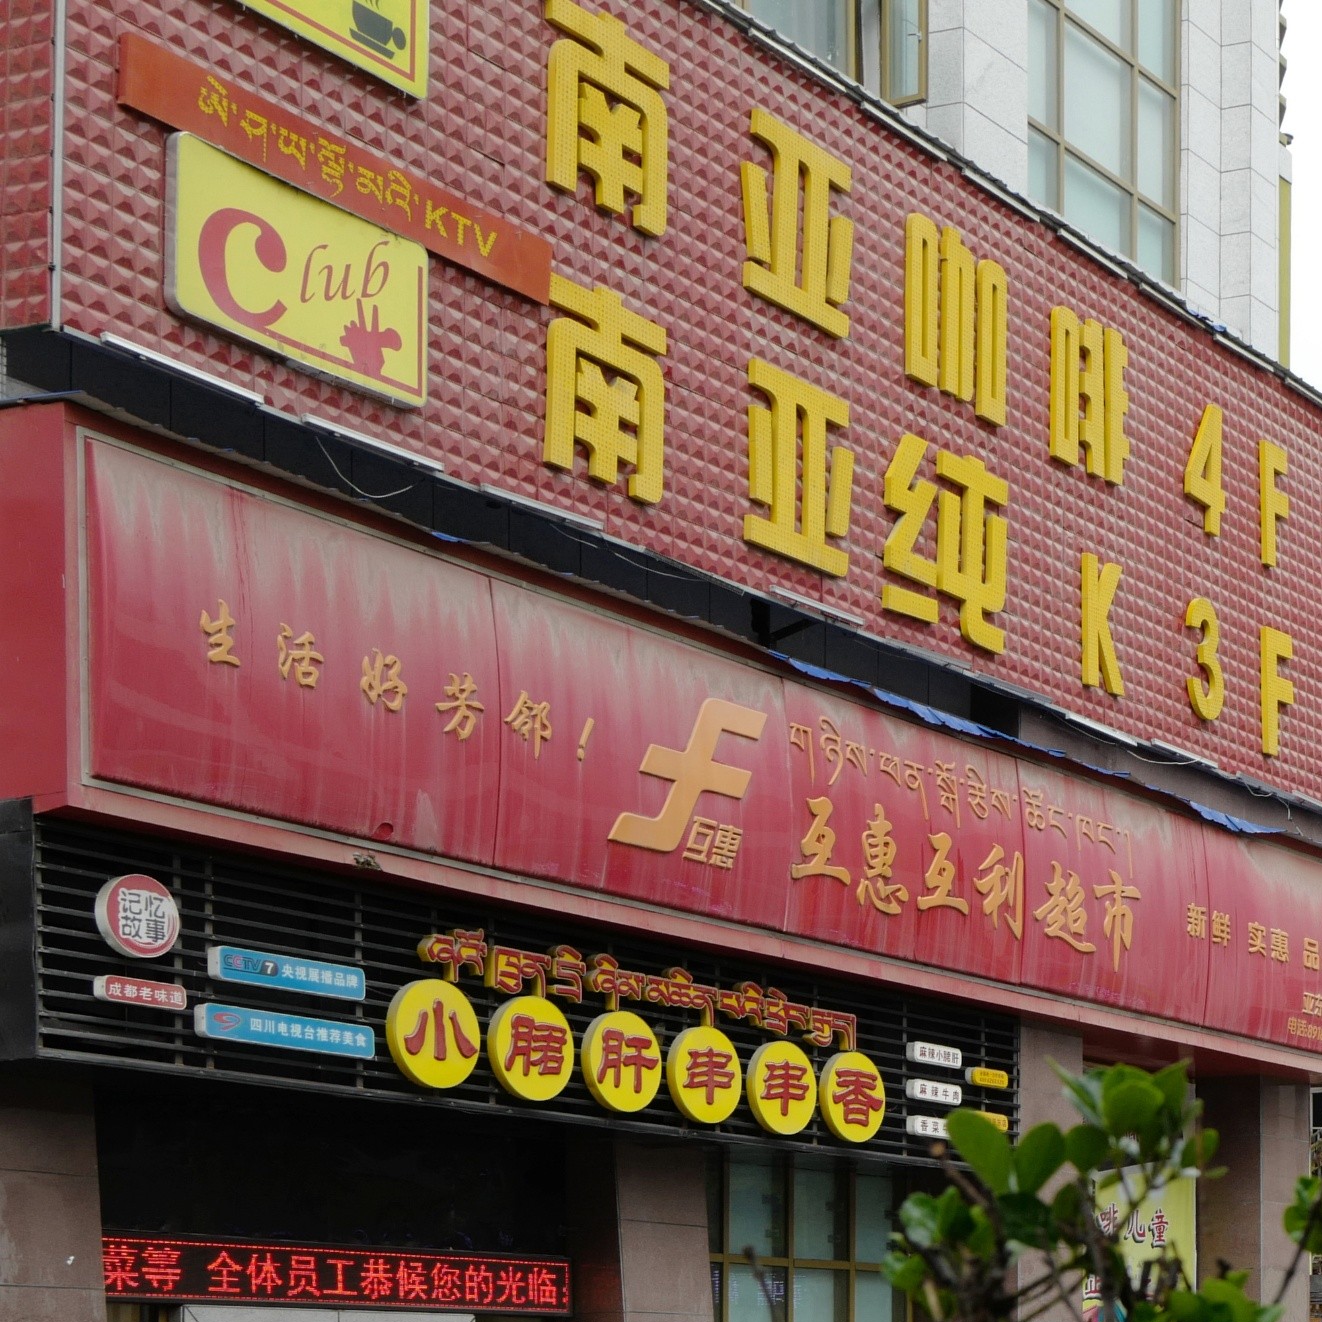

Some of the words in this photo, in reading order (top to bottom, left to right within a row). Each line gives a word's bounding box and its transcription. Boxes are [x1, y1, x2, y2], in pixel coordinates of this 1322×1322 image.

[425, 199, 497, 257] KTV
[198, 207, 390, 328] Club
[682, 816, 745, 870] 互惠
[792, 796, 1140, 972] 互惠互利超市
[1186, 902, 1231, 948] 新鲜
[1247, 921, 1290, 964] 实惠
[108, 982, 184, 1006] 成都老味道
[281, 963, 358, 989] 央视展播品牌
[250, 1017, 368, 1048] 四川电视台推荐美食
